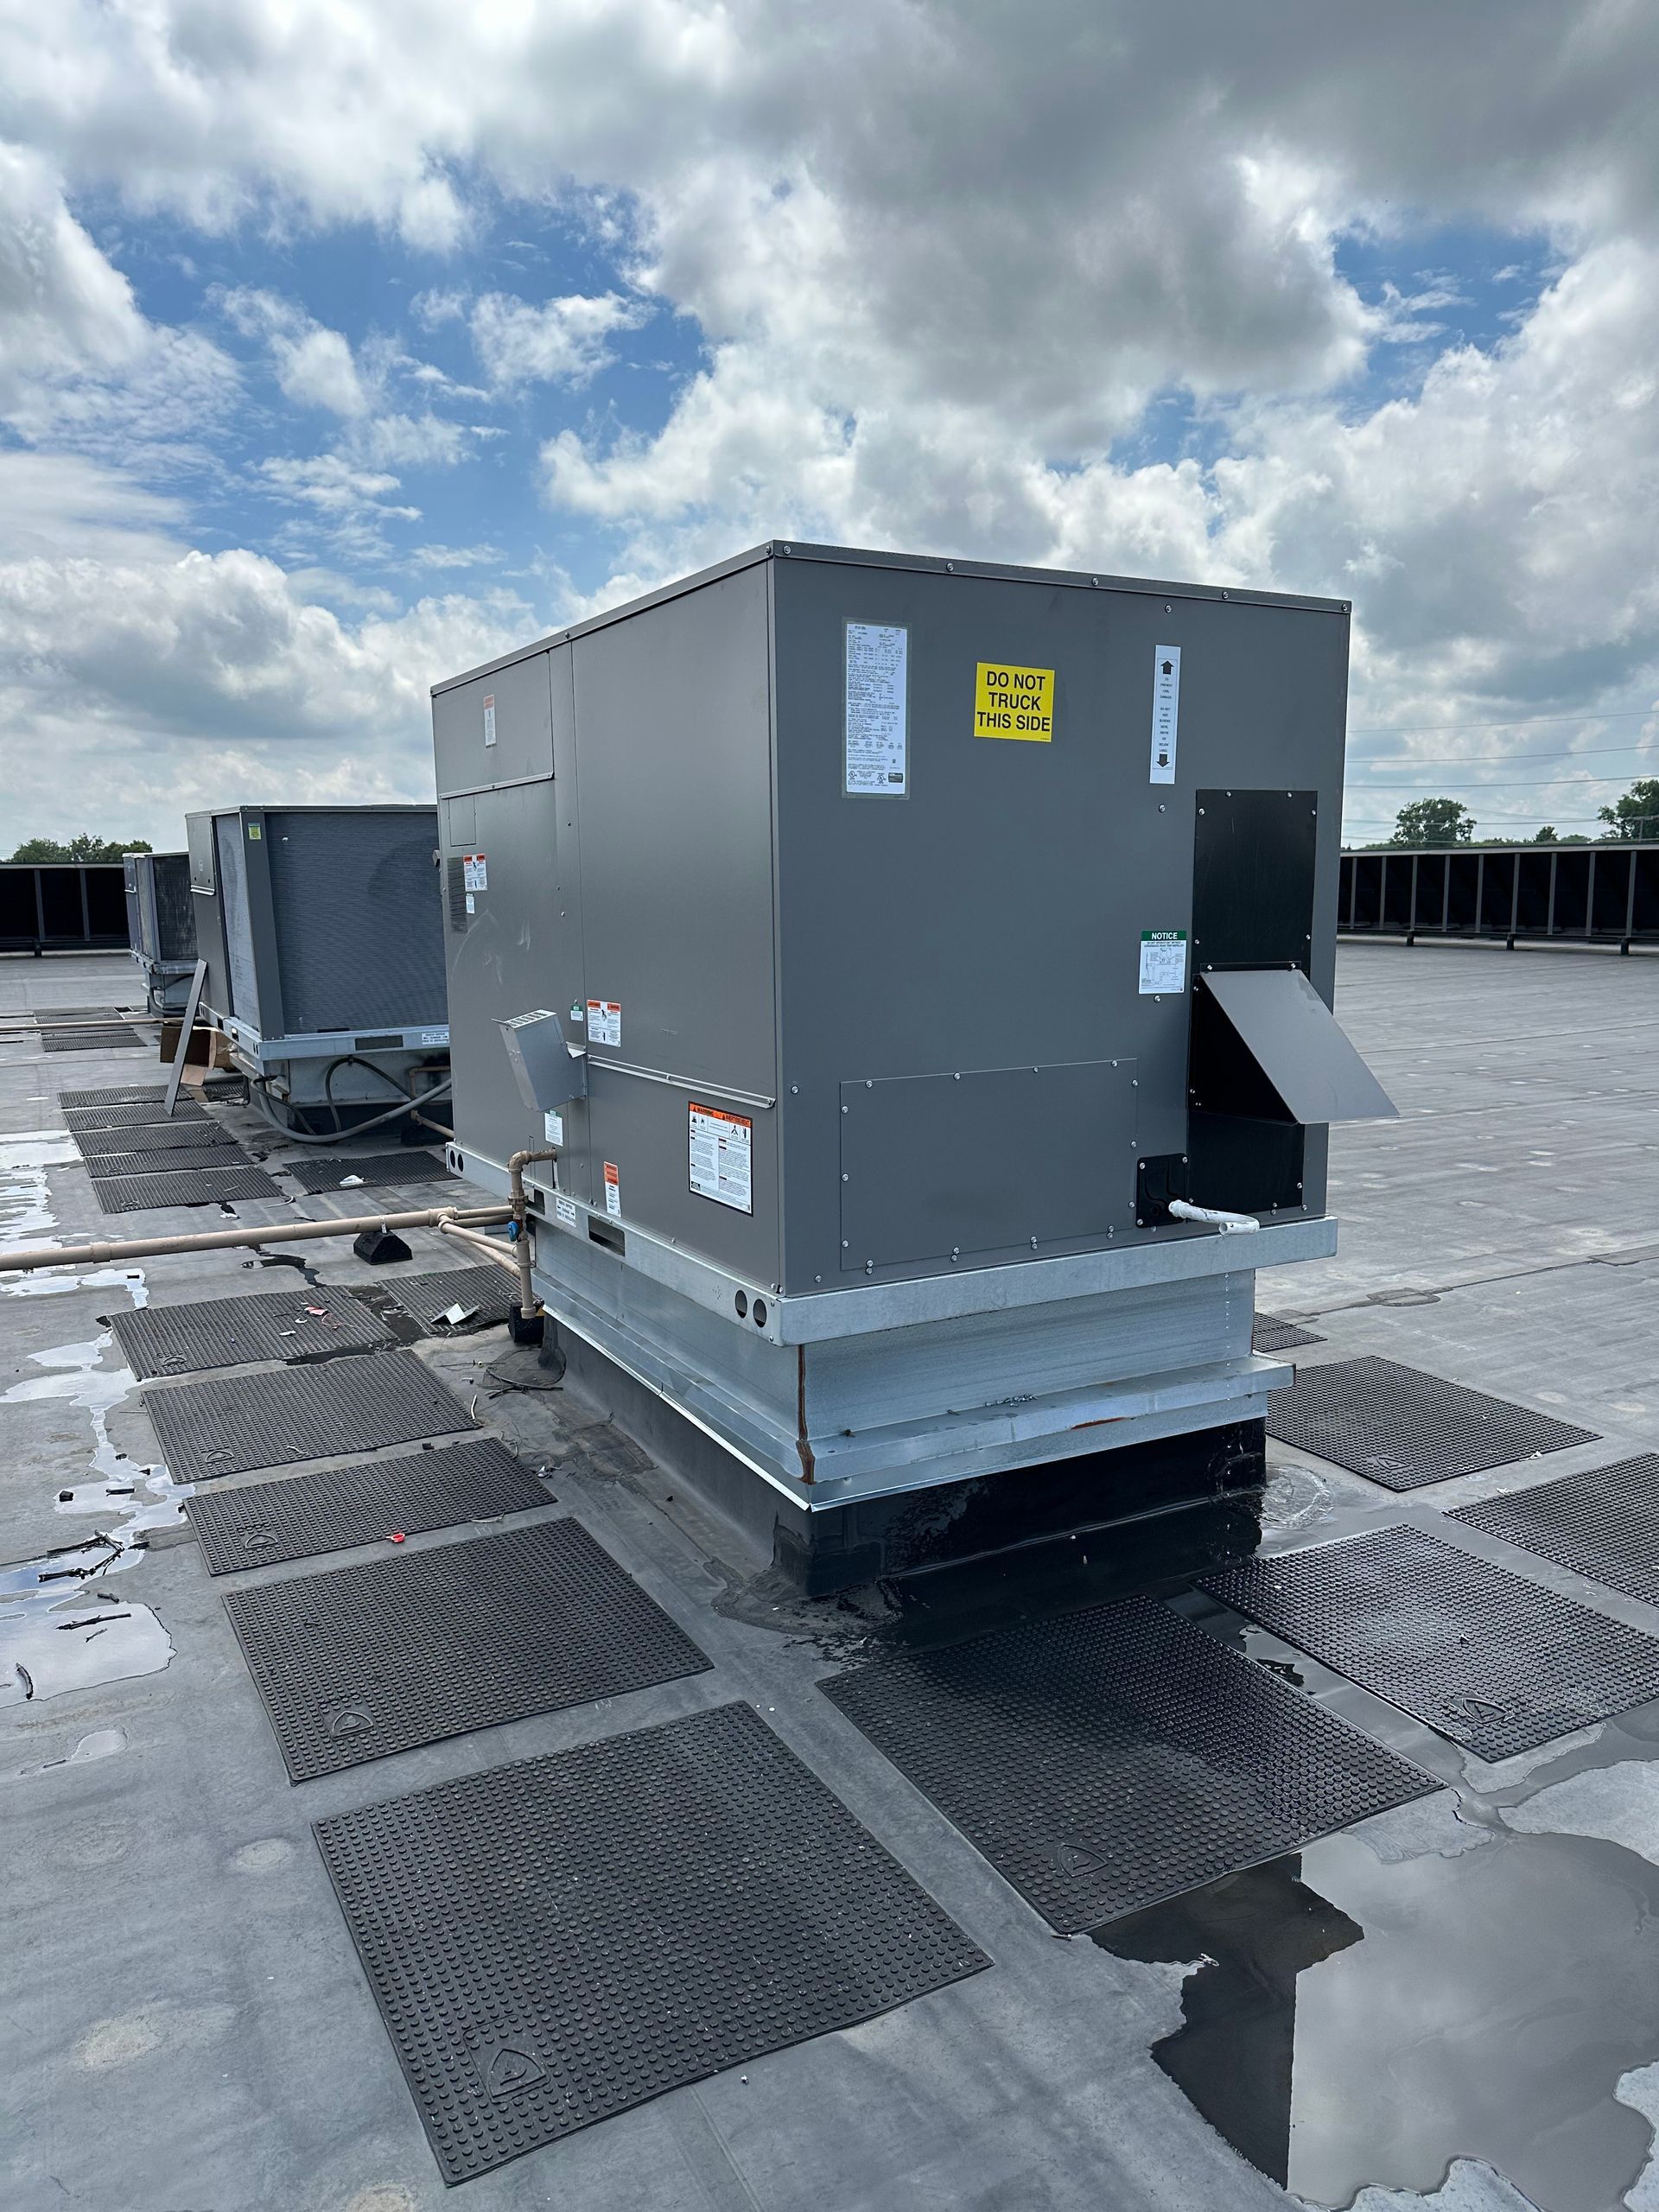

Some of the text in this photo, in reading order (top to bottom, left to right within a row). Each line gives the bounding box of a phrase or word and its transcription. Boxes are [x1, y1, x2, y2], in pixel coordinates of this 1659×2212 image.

[987, 671, 1046, 690] DO NOT
[988, 691, 1041, 711] TRUCK
[976, 711, 1051, 732] THIS SIDE
[1151, 931, 1179, 940] NOTICE
